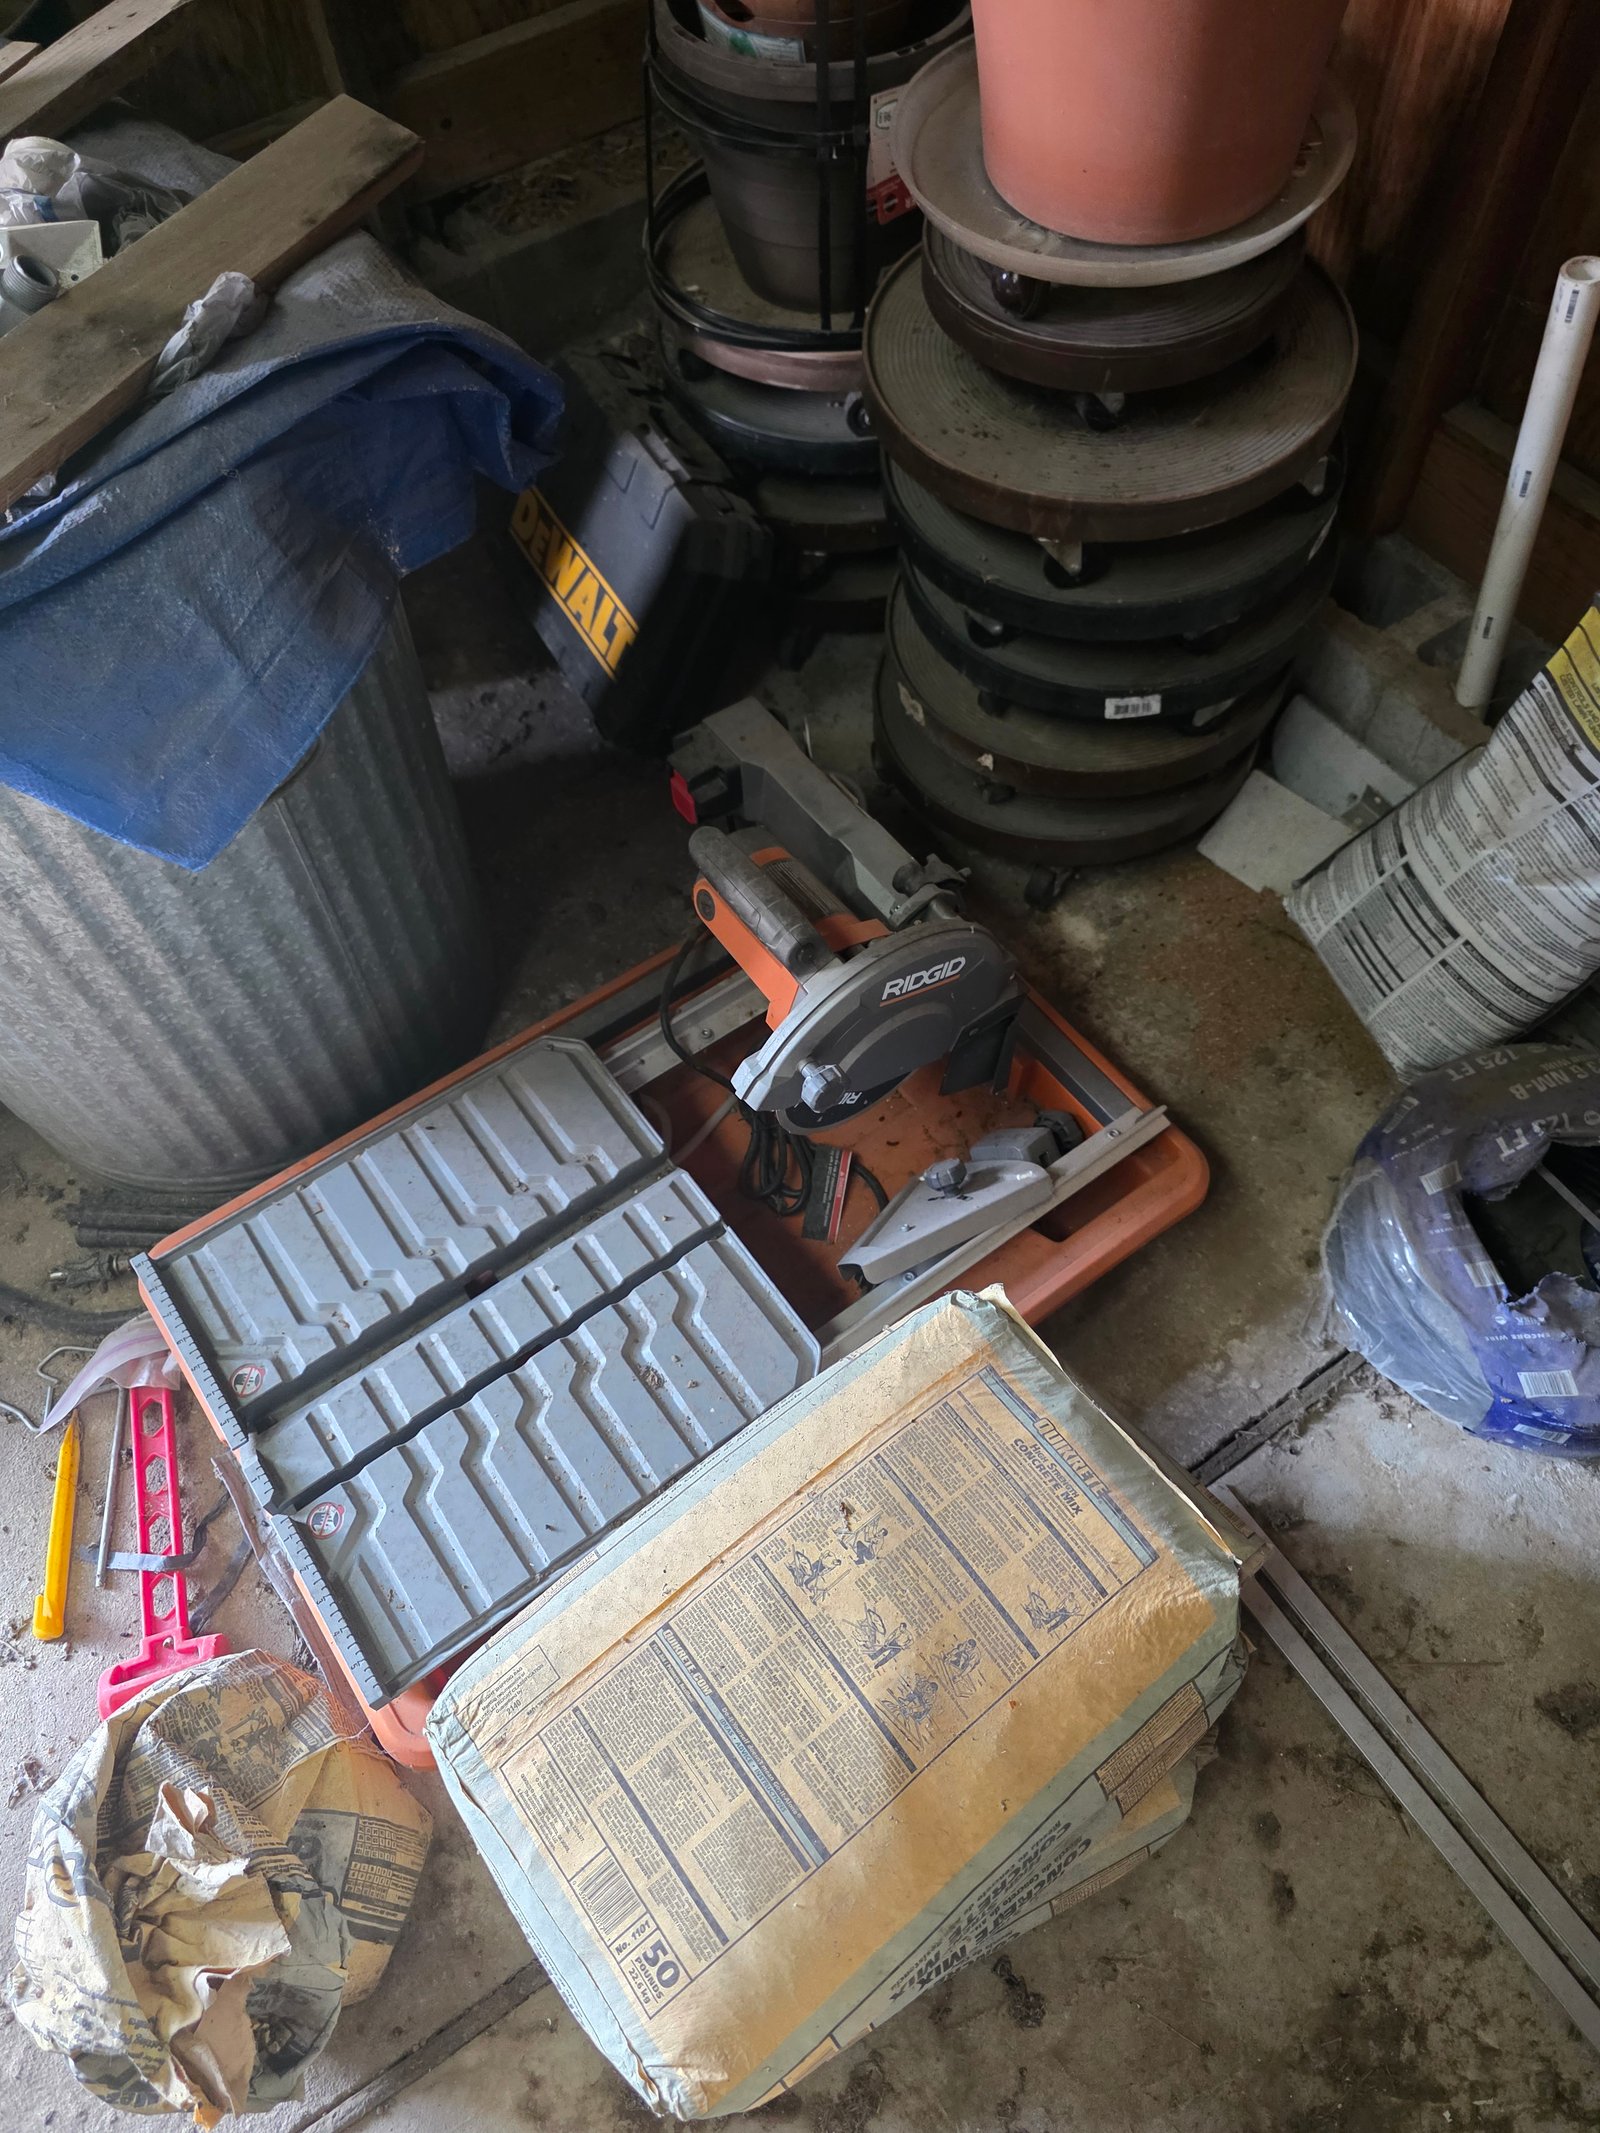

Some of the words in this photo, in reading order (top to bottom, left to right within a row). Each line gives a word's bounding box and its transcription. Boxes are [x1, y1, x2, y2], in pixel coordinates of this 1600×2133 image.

[515, 498, 638, 666] DEWALT
[881, 956, 966, 1001] RIDGID
[1445, 1061, 1477, 1082] FT
[1475, 1048, 1520, 1070] 125
[1508, 1069, 1573, 1100] NM-B
[1495, 1127, 1530, 1162] FT
[1011, 1436, 1063, 1492] CONCRETE
[1058, 1489, 1084, 1517] MIX
[1028, 1442, 1050, 1465] HIGH
[1045, 1461, 1081, 1499] STRENGTH
[1031, 1414, 1111, 1500] QUIKRETE
[651, 1643, 661, 1655] First
[658, 1653, 666, 1662] Aid
[661, 1627, 713, 1697] QUIKRETE.COM
[504, 1698, 523, 1715] 2140
[718, 1717, 734, 1737] IDEAS
[734, 1740, 753, 1764] ADVICE
[753, 1767, 787, 1813] INSTRUCTIONS
[760, 1763, 775, 1781] mean
[613, 1938, 631, 1955] No.
[629, 1919, 652, 1940] 1101
[627, 1966, 647, 1992] 22.6
[638, 1988, 654, 2004] kg
[633, 1955, 665, 2000] POUNDS
[638, 1937, 686, 1991] 50
[916, 1943, 968, 1993] MIX
